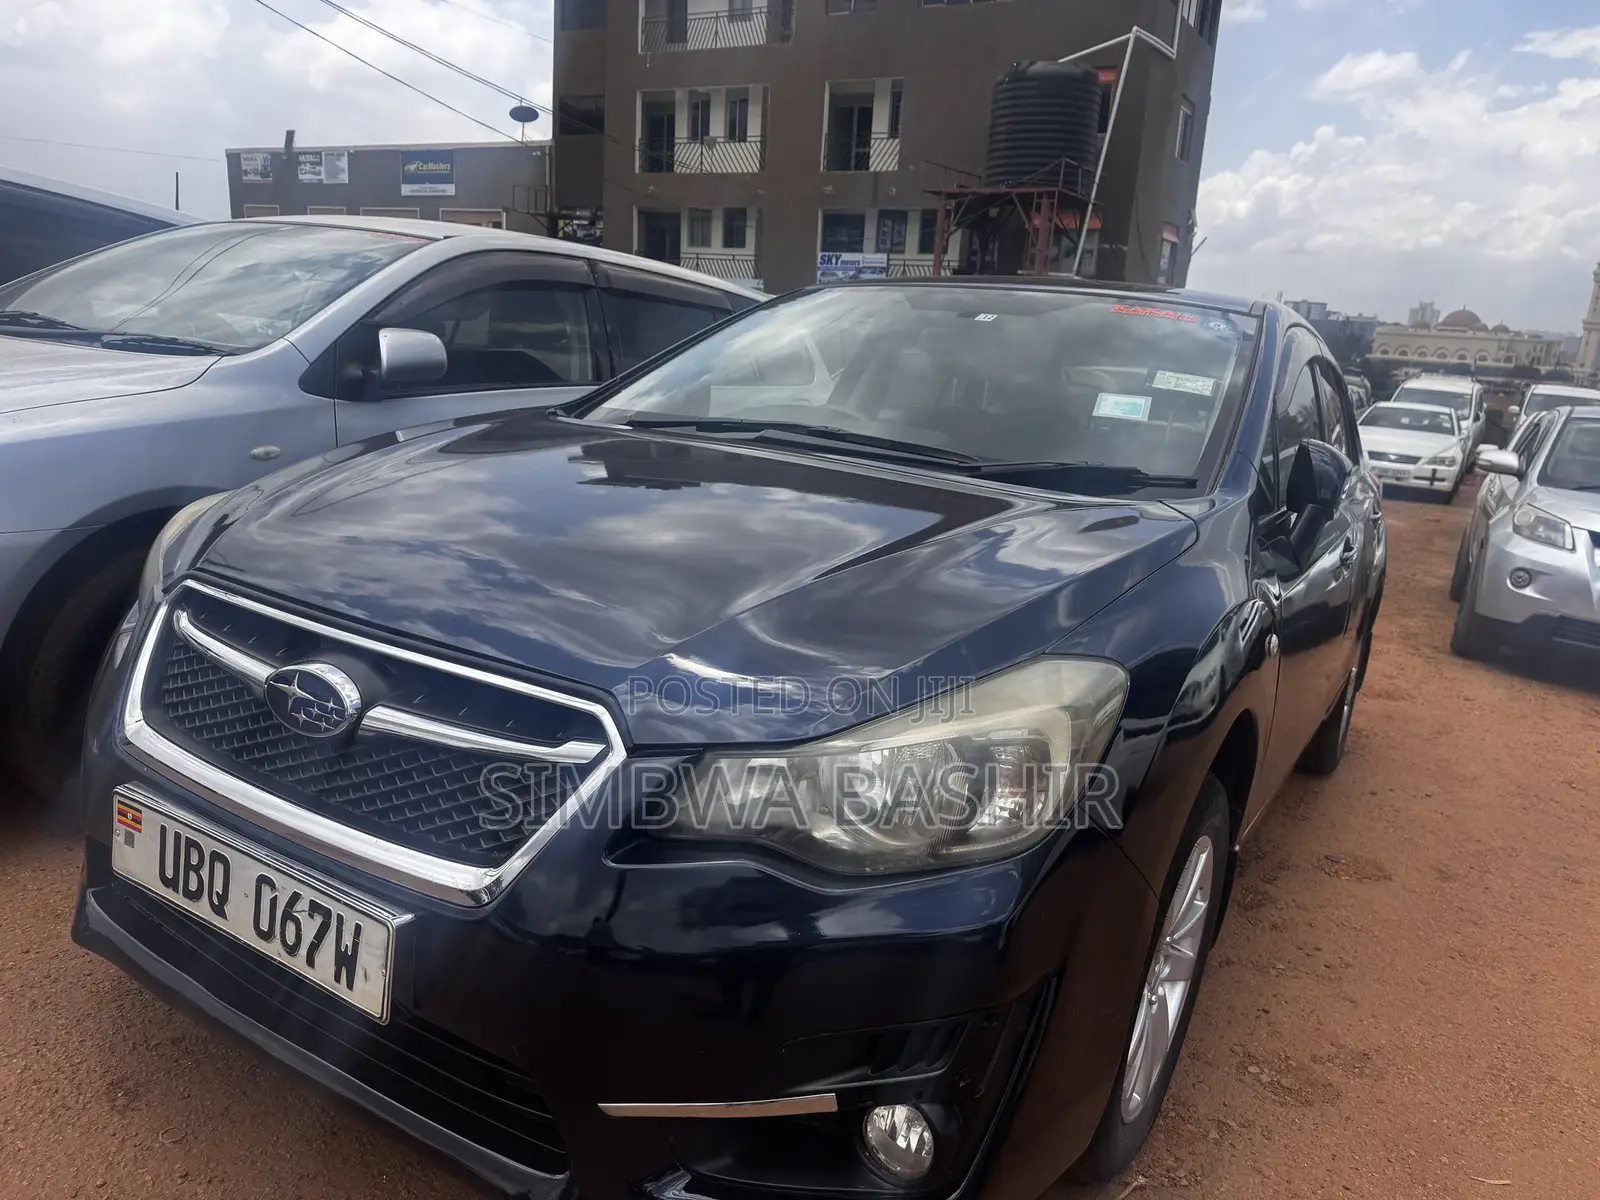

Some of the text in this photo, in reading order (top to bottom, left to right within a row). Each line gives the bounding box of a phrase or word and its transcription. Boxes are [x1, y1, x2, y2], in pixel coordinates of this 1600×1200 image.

[819, 253, 842, 266] SKY
[840, 259, 861, 267] motors
[158, 822, 363, 992] UBQ 067W
